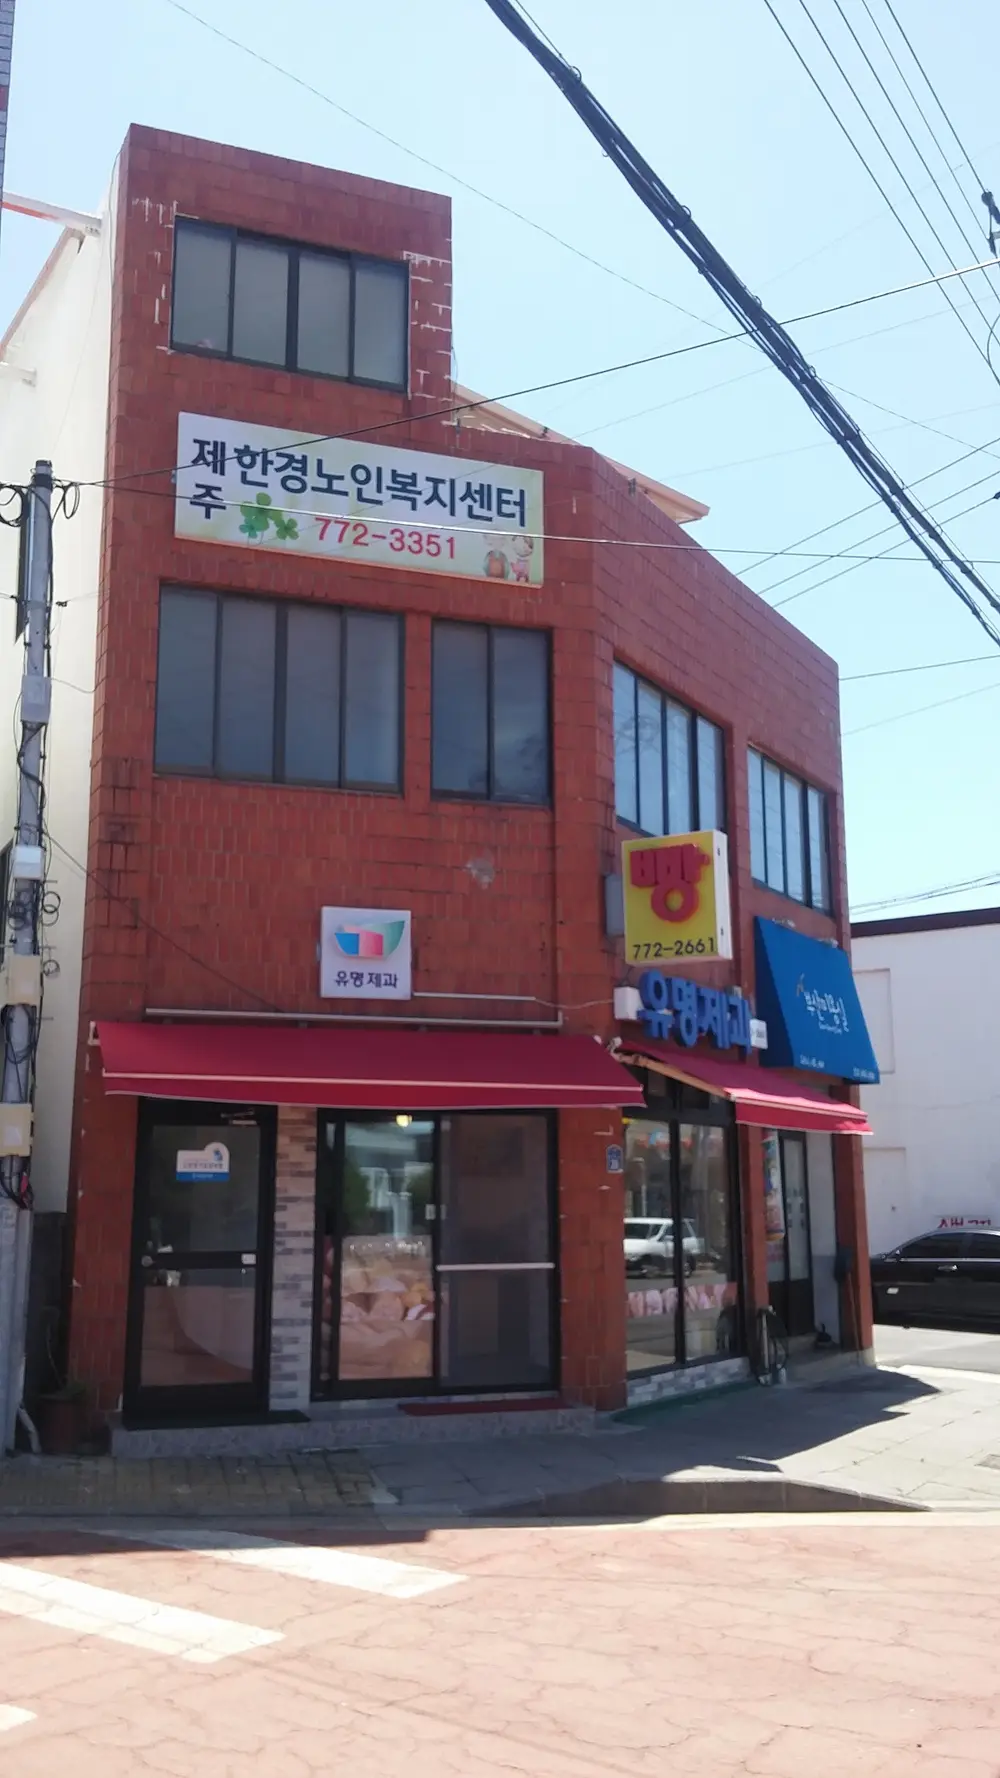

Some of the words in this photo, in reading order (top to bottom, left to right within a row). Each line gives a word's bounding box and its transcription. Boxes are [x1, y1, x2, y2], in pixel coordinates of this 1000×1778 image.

[234, 444, 526, 527] 한경노인복지센터
[315, 516, 456, 559] 772-3351
[630, 843, 710, 923] 빵
[632, 936, 716, 959] 772-2661
[638, 968, 752, 1054] 유명제과
